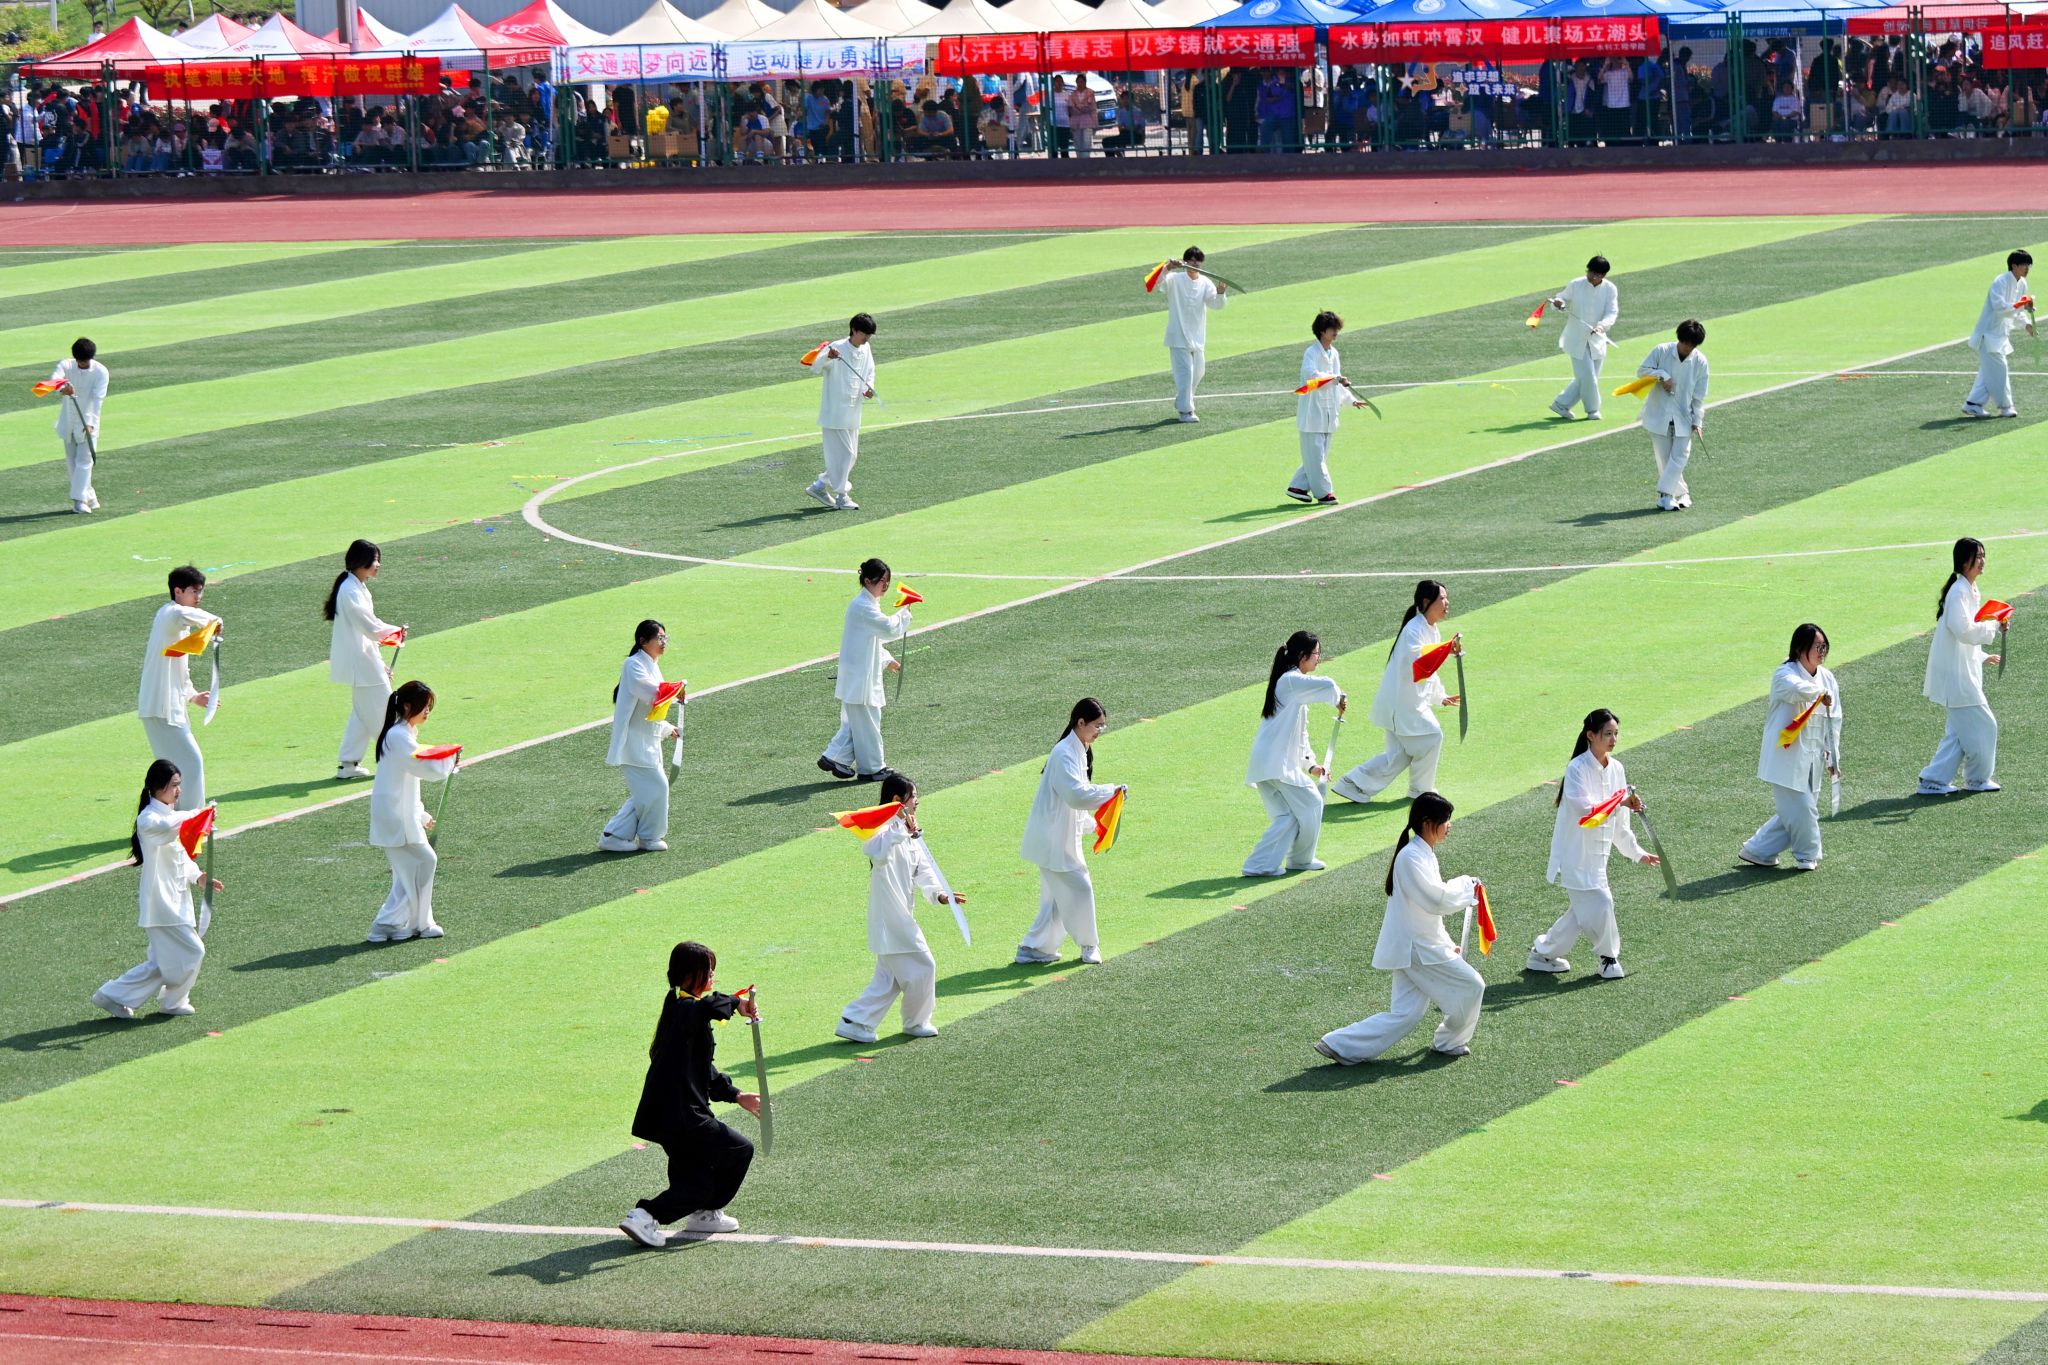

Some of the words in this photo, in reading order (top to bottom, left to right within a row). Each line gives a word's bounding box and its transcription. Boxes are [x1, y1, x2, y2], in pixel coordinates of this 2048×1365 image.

[948, 38, 1114, 63] 以汗书写青春志
[1130, 33, 1302, 57] 以梦铸就交通强
[1340, 27, 1484, 50] 水势如虹冲霄汉
[1500, 24, 1647, 45] 健儿赛场立潮头
[1989, 33, 2048, 50] 追风赶
[576, 49, 729, 75] 交通筑梦向远方
[747, 46, 904, 71] 运动健儿勇担当
[163, 66, 287, 88] 执笔测绘天地
[1468, 84, 1516, 96] 放飞未来
